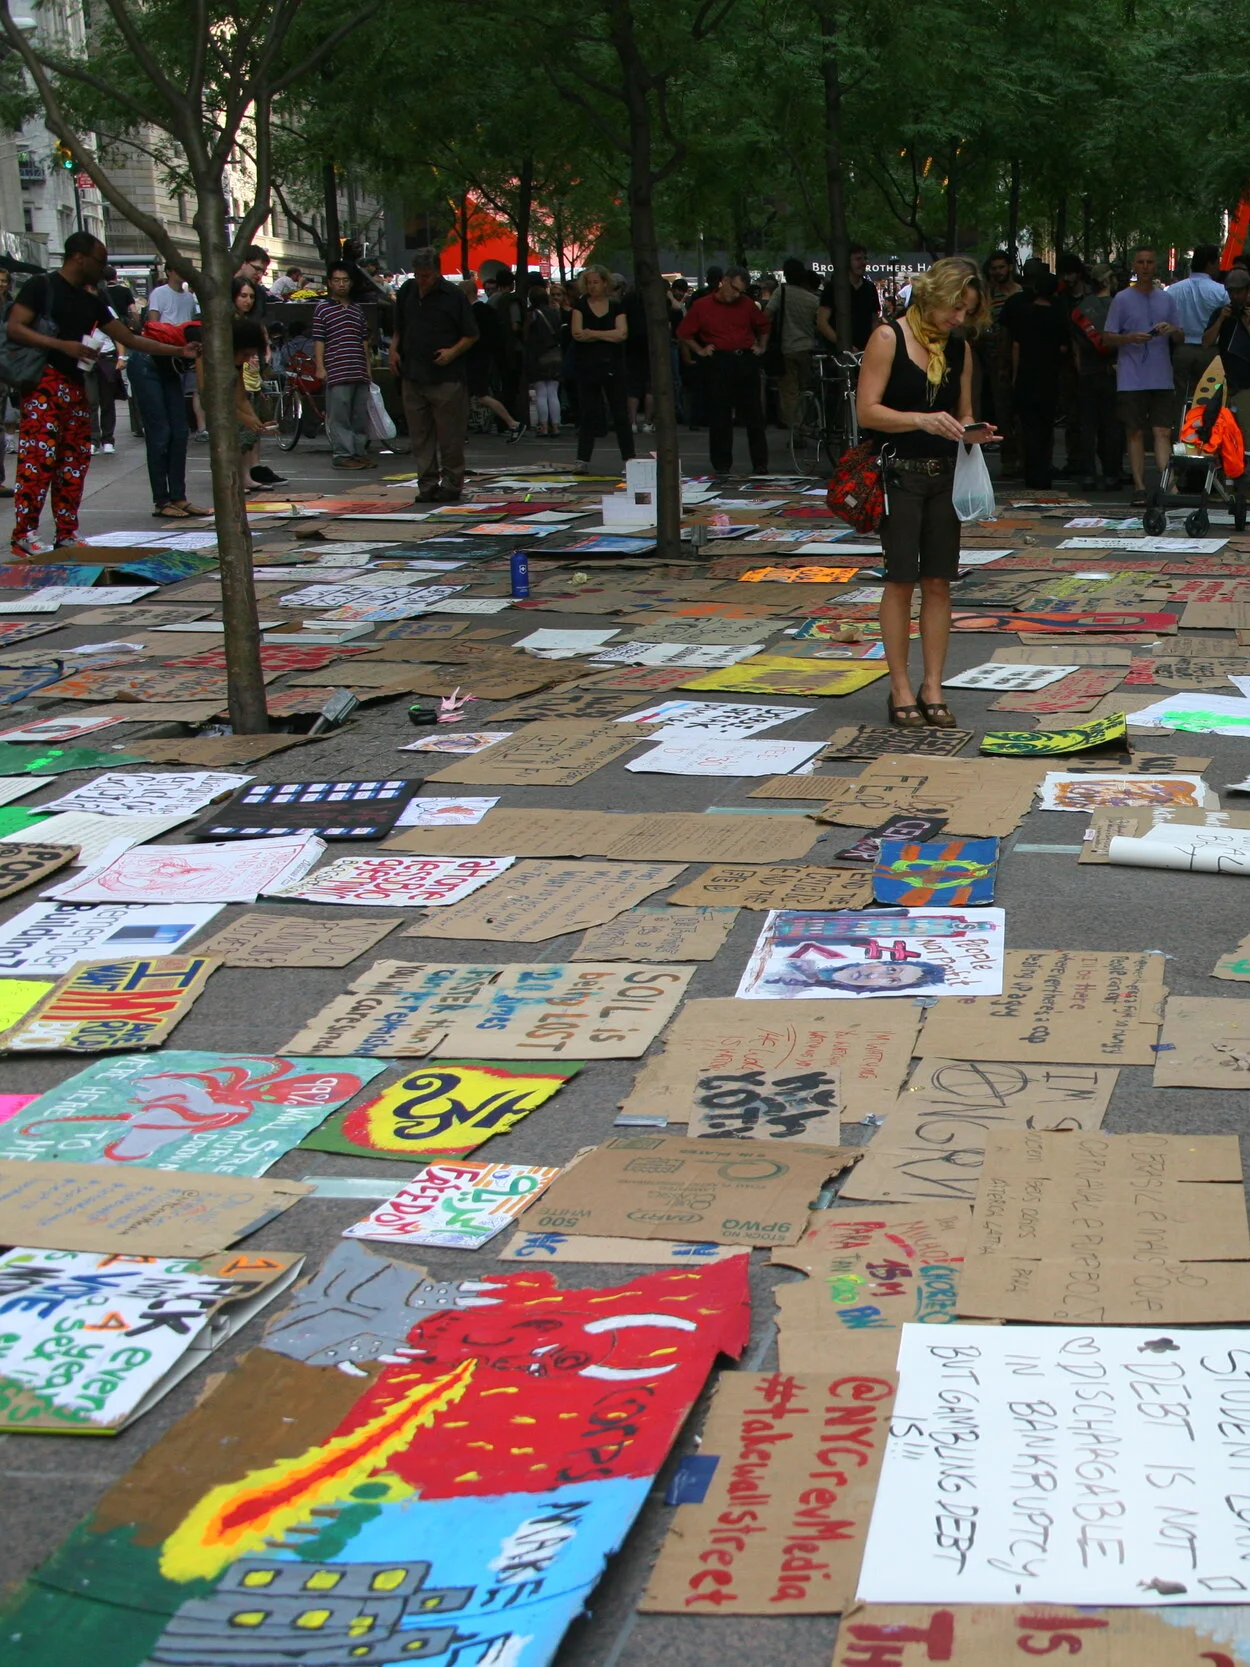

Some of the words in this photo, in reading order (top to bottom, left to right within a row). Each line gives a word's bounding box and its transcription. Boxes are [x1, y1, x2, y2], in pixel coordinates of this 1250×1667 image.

[812, 262, 835, 272] BRO
[865, 263, 913, 272] ROTHERS
[28, 903, 150, 969] Remember
[910, 939, 950, 955] NOT
[945, 938, 996, 972] People
[1013, 953, 1045, 979] beating
[123, 959, 206, 991] I
[361, 980, 413, 997] will
[412, 968, 458, 991] can
[506, 970, 559, 992] 20
[548, 972, 614, 1007] being
[40, 989, 185, 1023] MY
[425, 968, 497, 1016] FASTER
[599, 970, 680, 1019] SOIL
[334, 997, 383, 1024] care
[408, 1018, 455, 1044] than
[517, 1013, 587, 1052] LOST
[588, 1028, 639, 1043] is
[1018, 1025, 1050, 1044] cop
[43, 1085, 99, 1118] HERE
[286, 1075, 340, 1106] 99%
[258, 1104, 314, 1132] WALL
[57, 1129, 110, 1151] TO
[371, 1164, 476, 1238] FREEDOM
[532, 1204, 592, 1218] WHITE
[636, 1211, 696, 1222] DART
[532, 1214, 583, 1229] 500
[717, 1216, 790, 1235] 9PWQ
[832, 1221, 889, 1250] PARA
[829, 1252, 862, 1272] TAN
[0, 1270, 143, 1320] VOTE
[82, 1310, 131, 1332] 4
[927, 1345, 982, 1385] BUT
[1004, 1354, 1043, 1376] IN
[51, 1345, 153, 1424] every
[1123, 1361, 1195, 1442] DEBT
[920, 1389, 980, 1493] GAMBLING
[1050, 1362, 1125, 1567] DISCHARGABLE
[1144, 1464, 1195, 1489] IS
[687, 1372, 805, 1605] #takewallstreet
[774, 1376, 891, 1602] @NYCrevMedia
[935, 1500, 979, 1574] DEBT
[1159, 1506, 1198, 1570] NOT
[480, 1500, 593, 1609] MAKE
